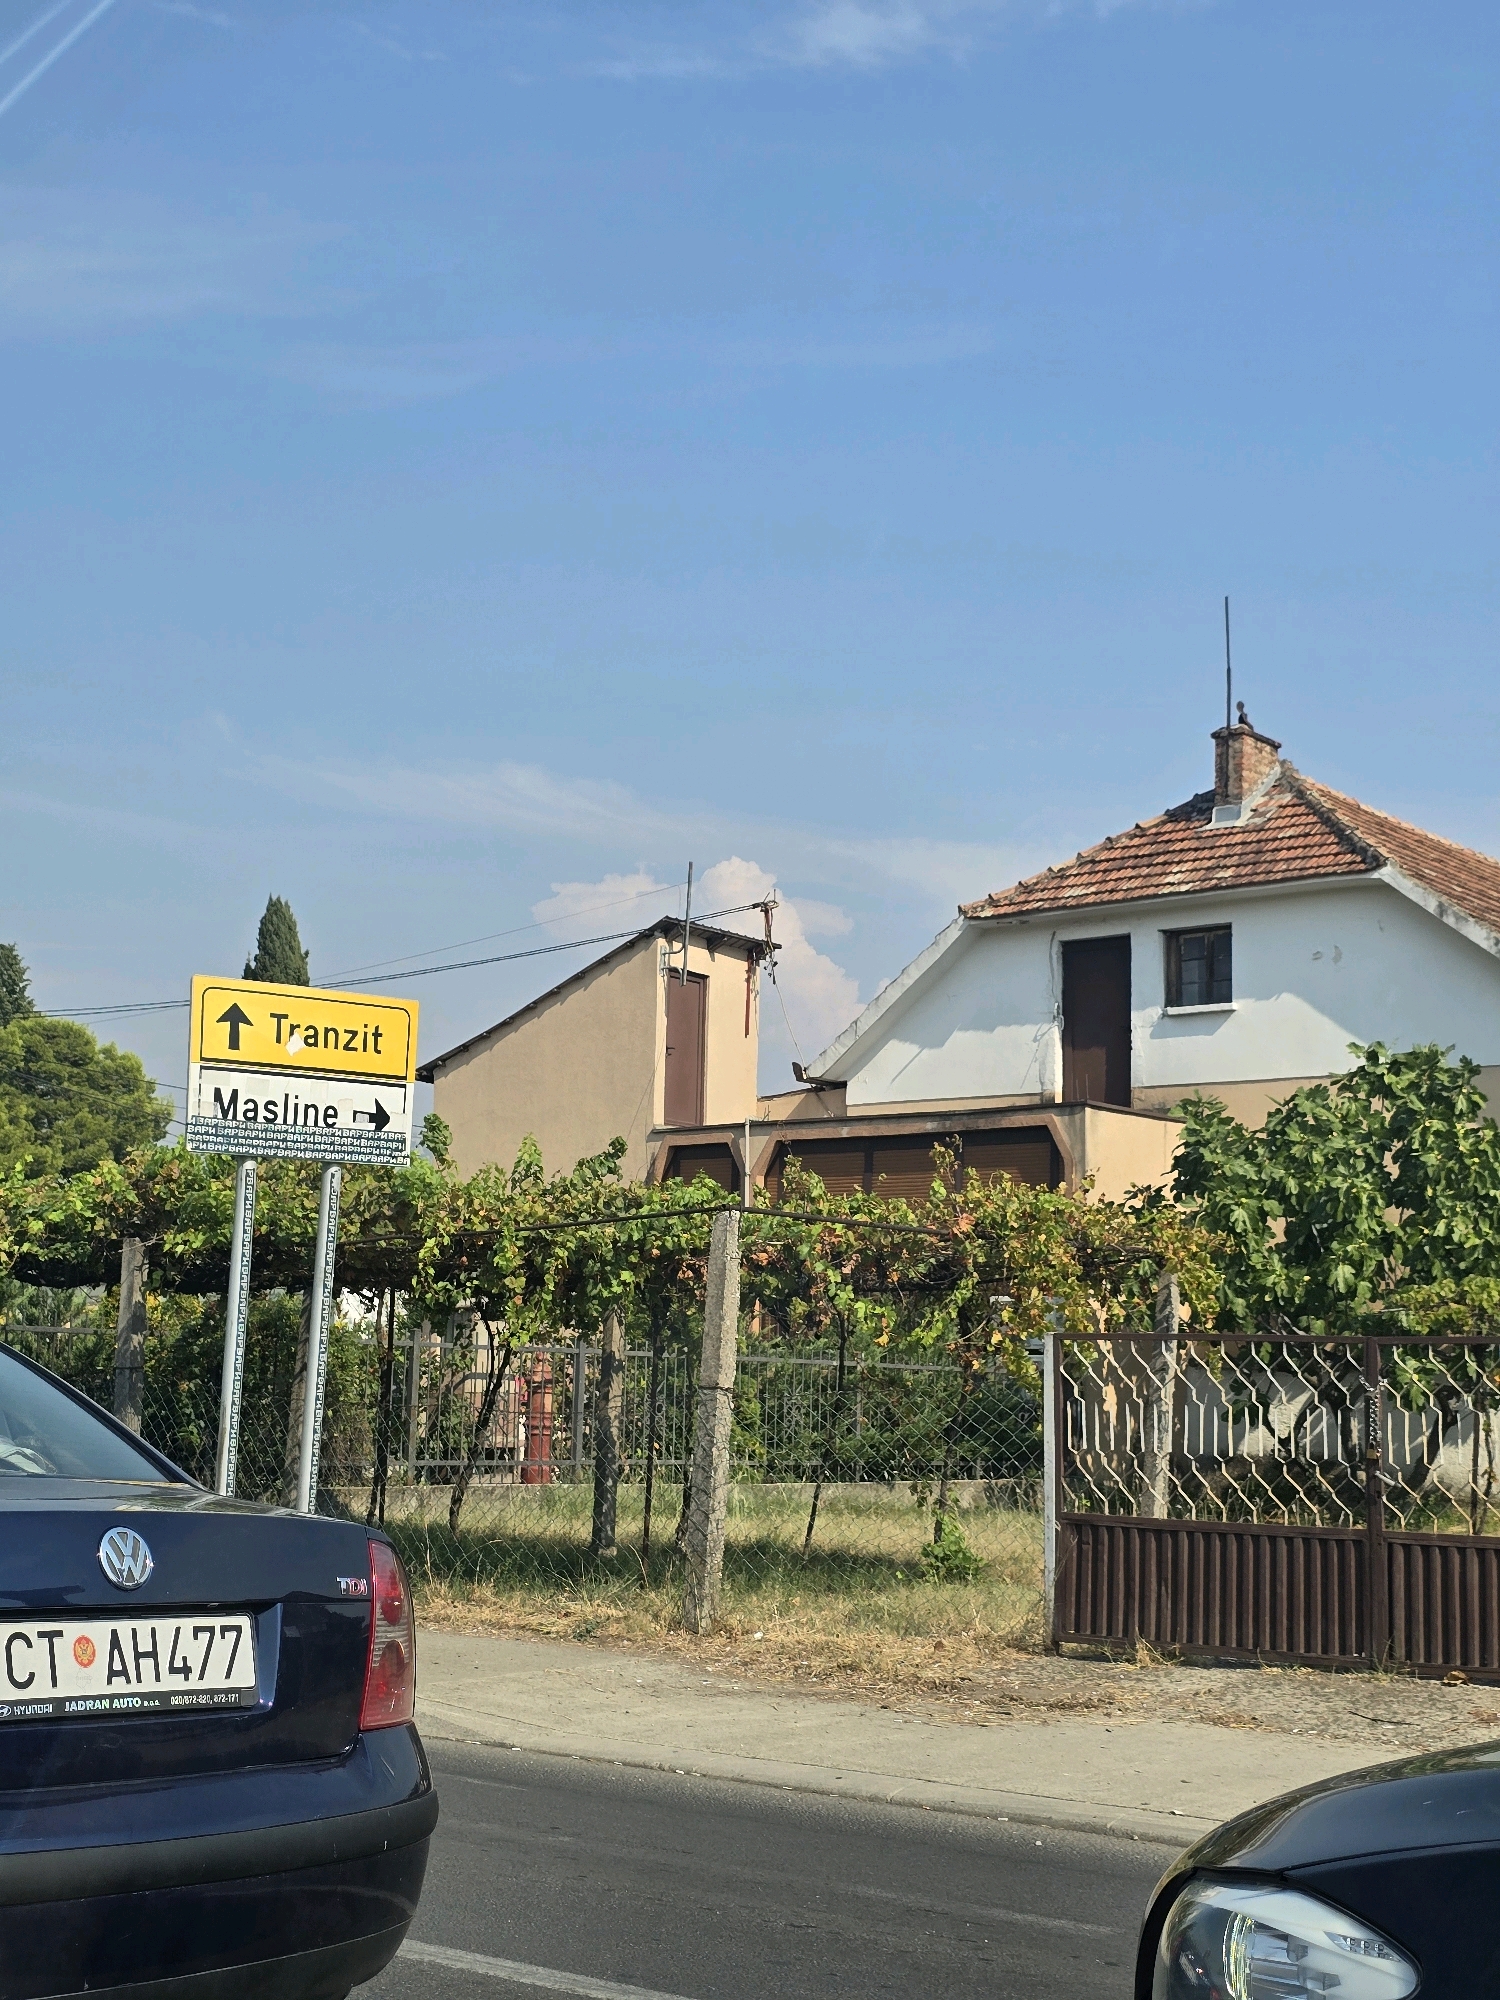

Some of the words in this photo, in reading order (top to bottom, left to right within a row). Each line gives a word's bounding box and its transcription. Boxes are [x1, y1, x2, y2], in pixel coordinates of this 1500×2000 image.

[270, 1012, 383, 1054] Tranzit
[214, 1087, 338, 1128] Masline
[5, 1630, 64, 1689] CT
[14, 1704, 53, 1715] HYUNDAI
[65, 1699, 110, 1712] JADRAN
[113, 1697, 142, 1709] AUTO
